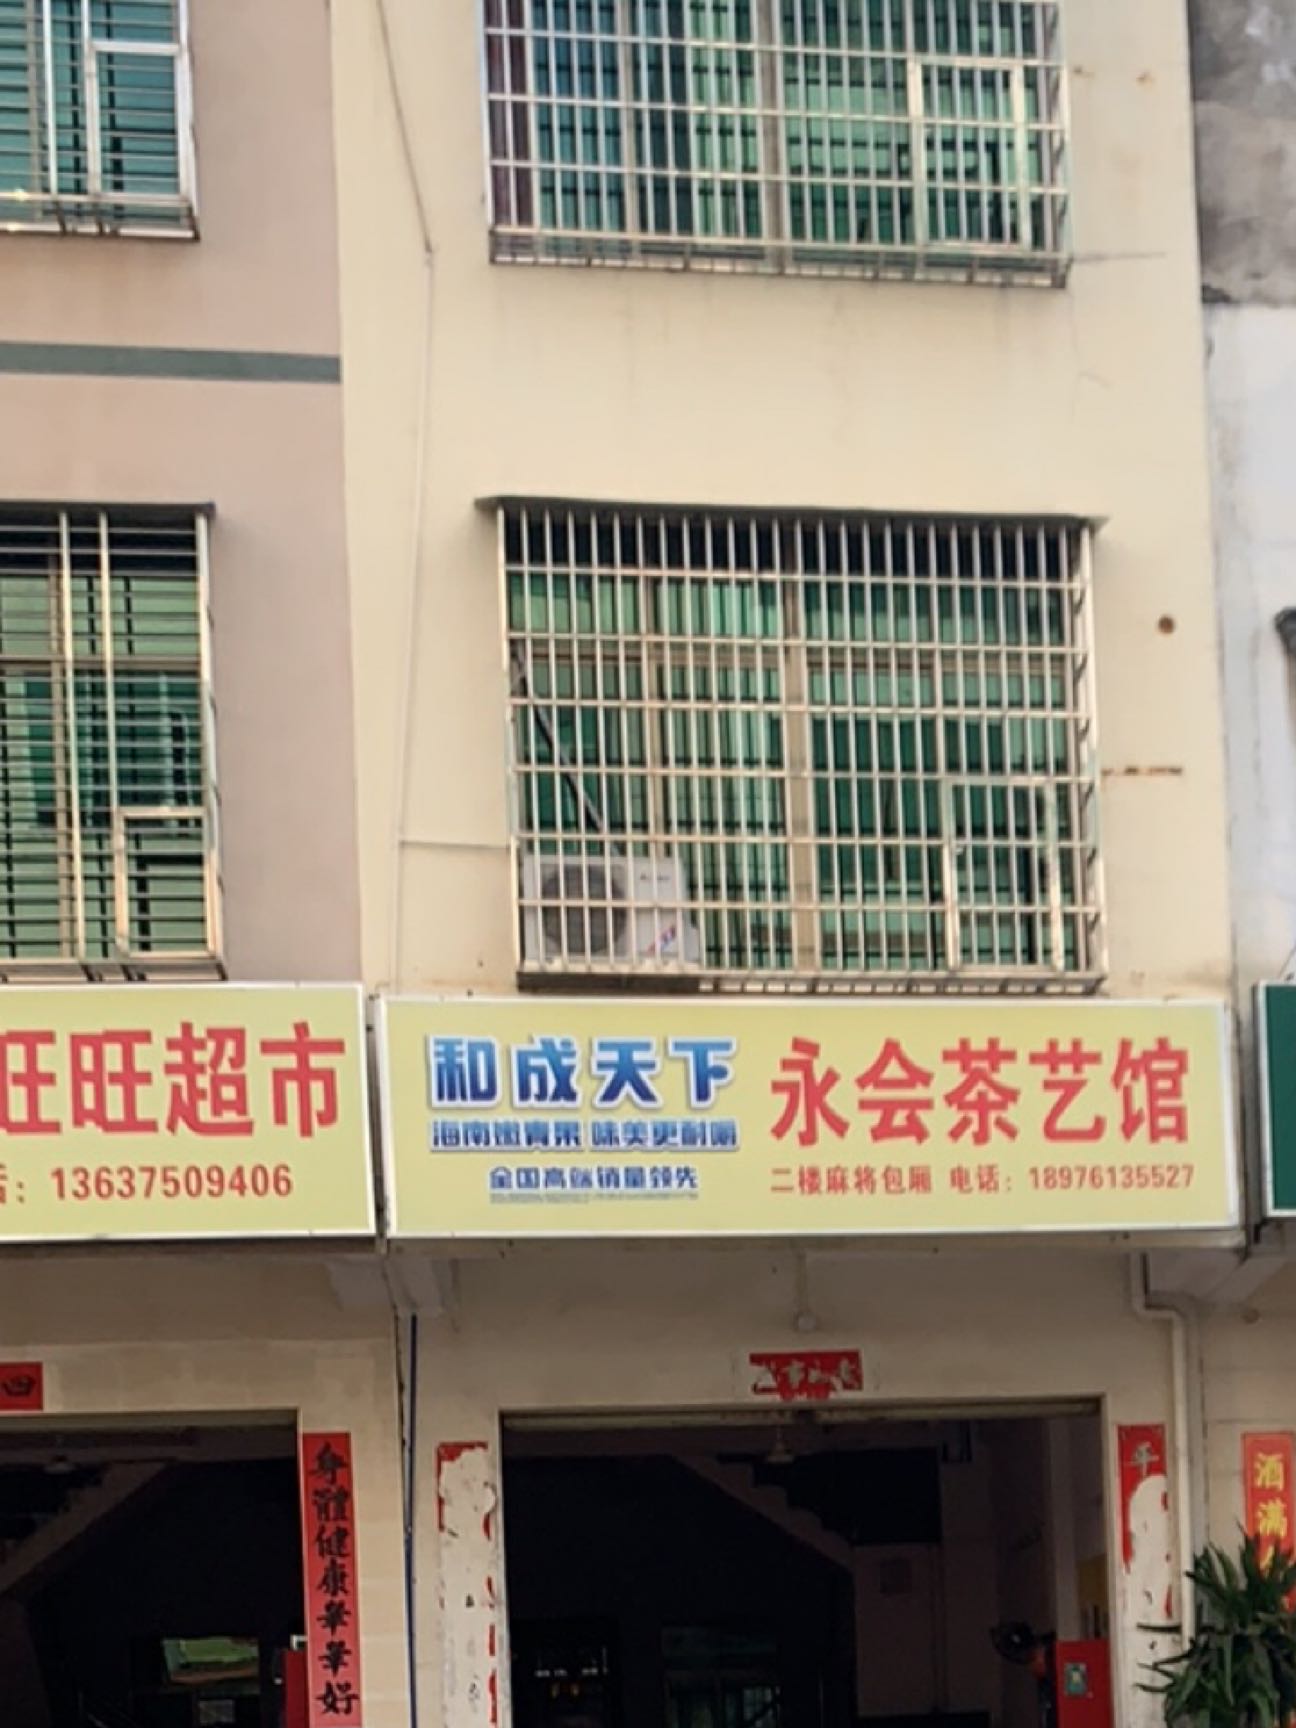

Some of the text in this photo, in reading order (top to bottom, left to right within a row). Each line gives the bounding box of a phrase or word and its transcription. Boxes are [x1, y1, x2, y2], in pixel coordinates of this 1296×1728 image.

[0, 1021, 346, 1138] 旺旺超市
[430, 1034, 740, 1110] 和成天下
[770, 1036, 1190, 1147] 永会茶艺馆
[50, 1164, 294, 1201] 13637509406
[770, 1165, 932, 1195] 二楼麻将包厢
[1028, 1163, 1195, 1190] 18976135527
